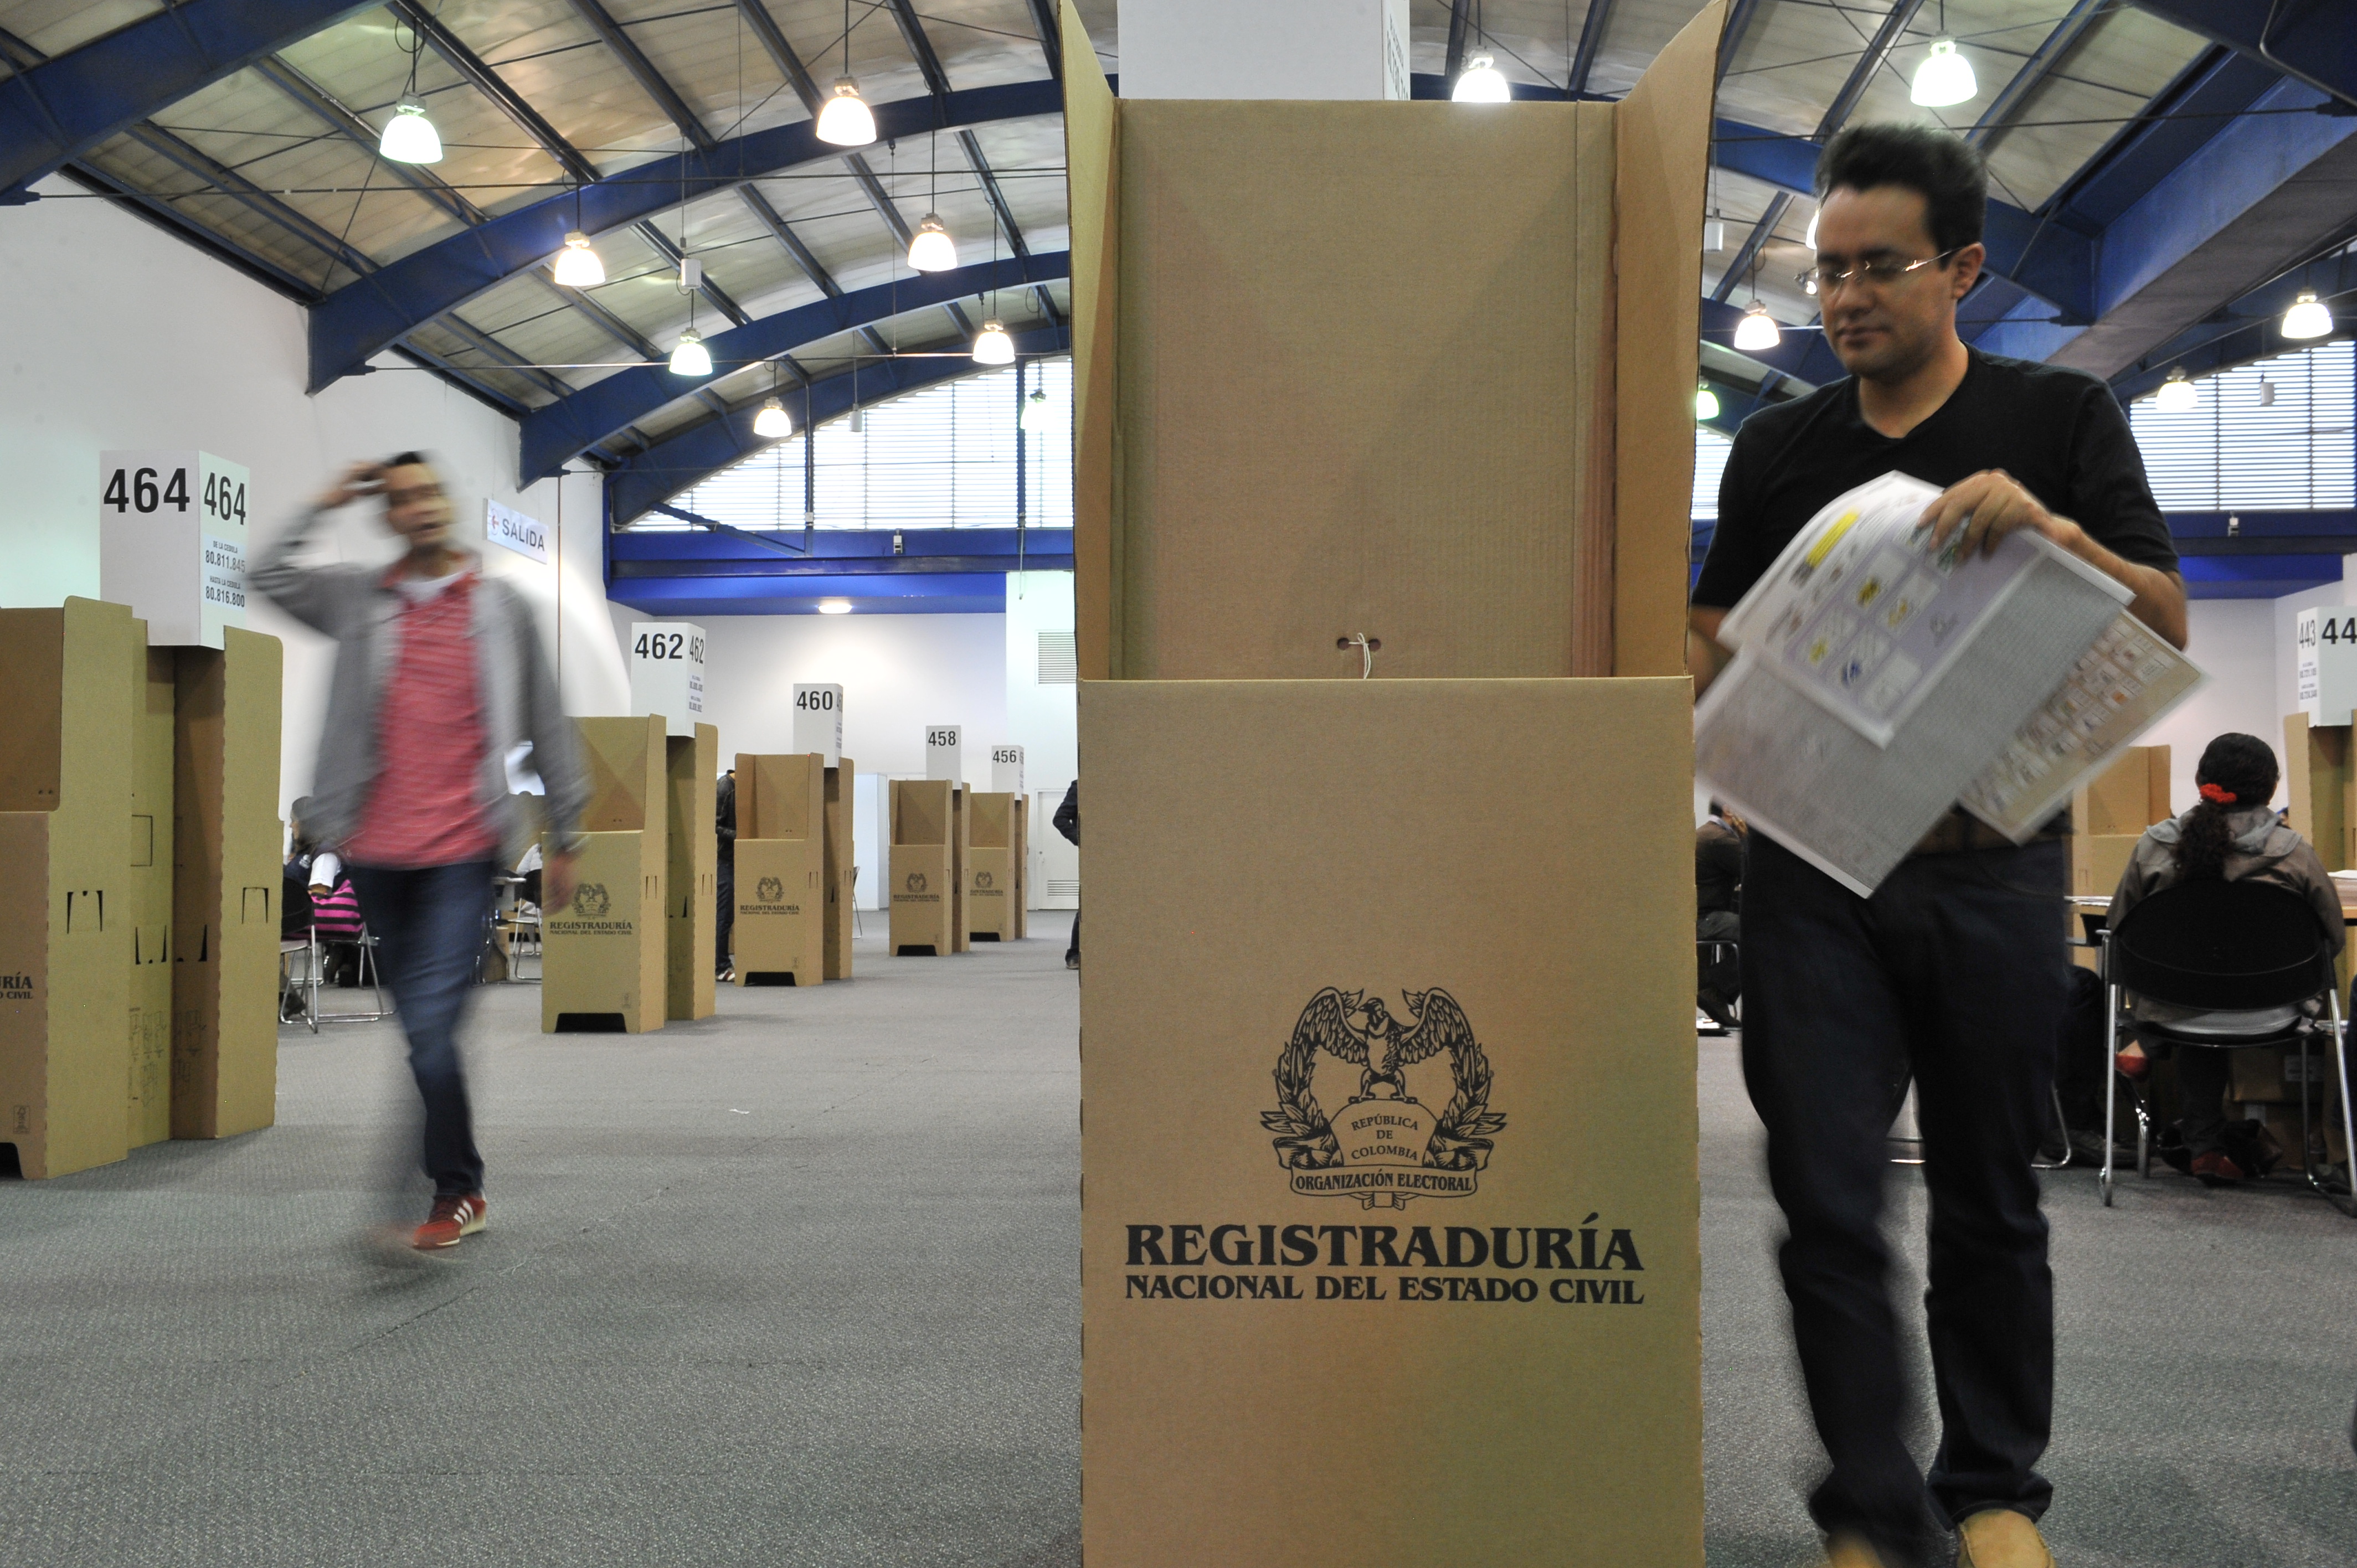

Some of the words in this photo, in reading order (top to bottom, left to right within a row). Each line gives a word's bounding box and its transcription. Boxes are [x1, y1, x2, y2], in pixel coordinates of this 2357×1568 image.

[104, 467, 190, 513] 464
[204, 472, 246, 525] 464
[502, 518, 544, 551] SALIDA
[205, 550, 245, 573] 80.811.845
[206, 586, 245, 607] 80.816.800
[2299, 620, 2316, 648] 443
[635, 633, 683, 659] 462
[689, 635, 704, 664] 462
[796, 691, 833, 710] 460
[928, 731, 956, 746] 458
[992, 750, 1017, 763] 456
[550, 920, 632, 929] REGISTRADURÍA
[0, 971, 33, 989] RÍA
[1351, 1113, 1418, 1131] REPÚBLICA
[1376, 1130, 1393, 1139] DE
[1351, 1146, 1417, 1160] COLOMBIA
[1296, 1169, 1393, 1190] ORGANIZACIÓN
[1397, 1173, 1472, 1191] ELECTORAL
[1125, 1212, 1644, 1271] REGISTRADURÍA
[1125, 1275, 1304, 1299] NACIONAL
[1315, 1276, 1387, 1300] DEL
[1399, 1277, 1538, 1302] ESTADO
[1550, 1279, 1644, 1304] CIVIL
